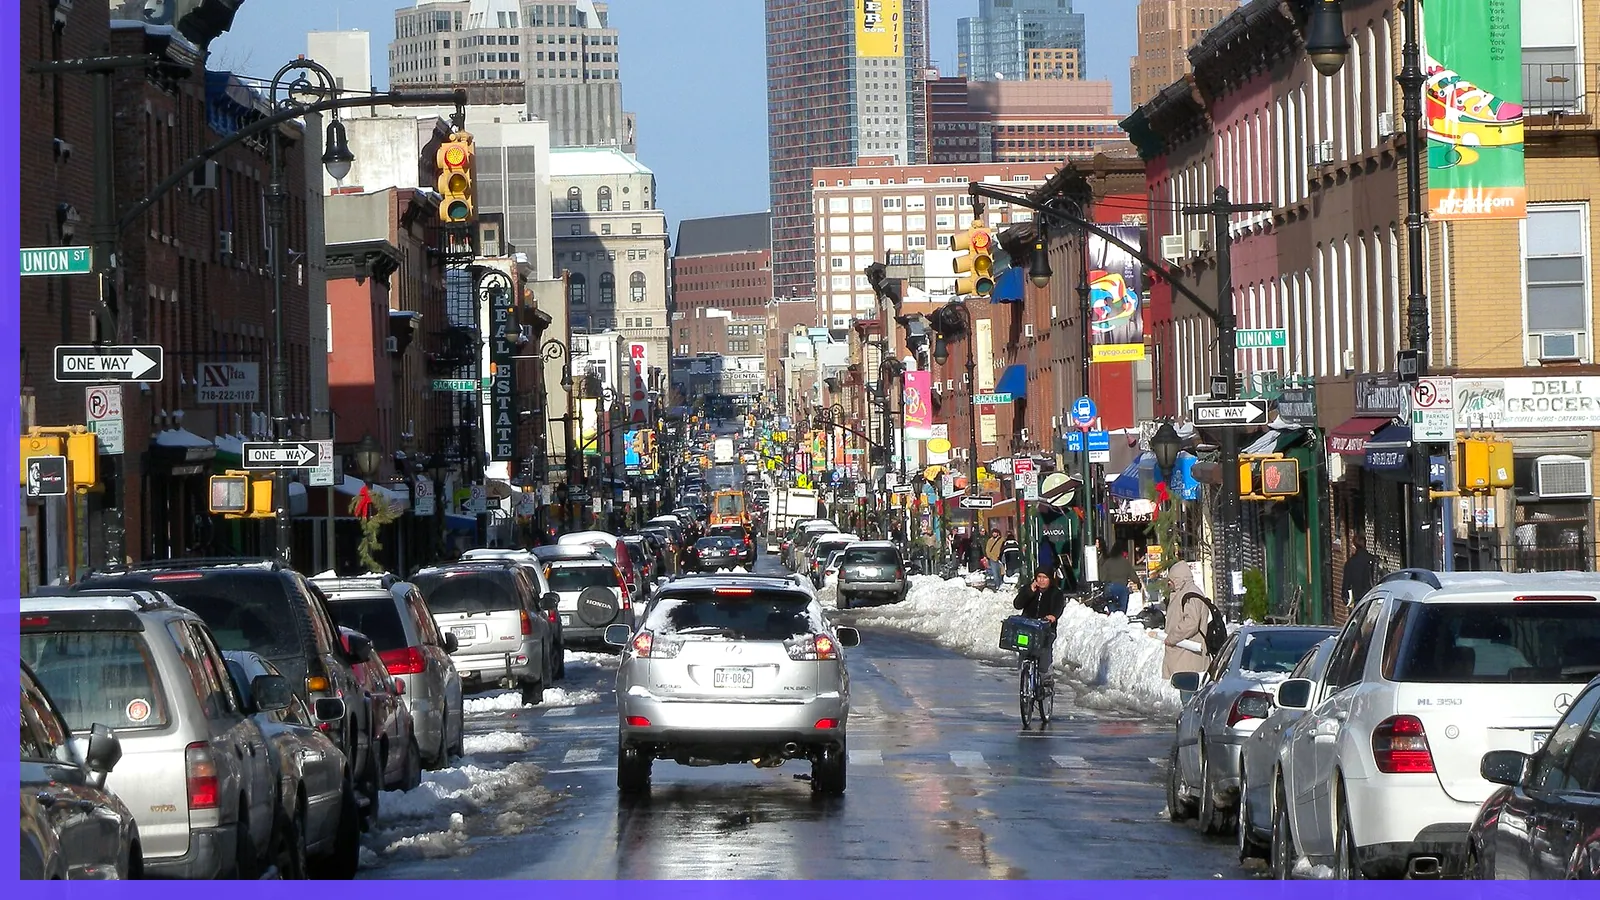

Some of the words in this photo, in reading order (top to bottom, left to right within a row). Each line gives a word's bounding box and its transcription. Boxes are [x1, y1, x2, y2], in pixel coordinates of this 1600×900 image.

[22, 251, 69, 272] UNION
[73, 250, 85, 261] ST
[494, 288, 510, 354] REAL
[1240, 331, 1272, 346] UNION
[1275, 331, 1285, 339] ST
[1098, 347, 1138, 357] nycgo.com
[67, 357, 95, 371] ONE
[101, 357, 130, 371] WAY
[433, 381, 466, 390] SACKETT
[1532, 380, 1583, 396] DELI
[201, 390, 255, 400] 718-222-1187
[496, 364, 512, 457] ESTATE
[1201, 409, 1220, 418] ONE
[1224, 408, 1244, 417] WAY
[254, 450, 276, 460] ONE
[286, 450, 308, 459] WAY
[585, 599, 612, 609] HONDA
[716, 673, 751, 684] DZF-0862
